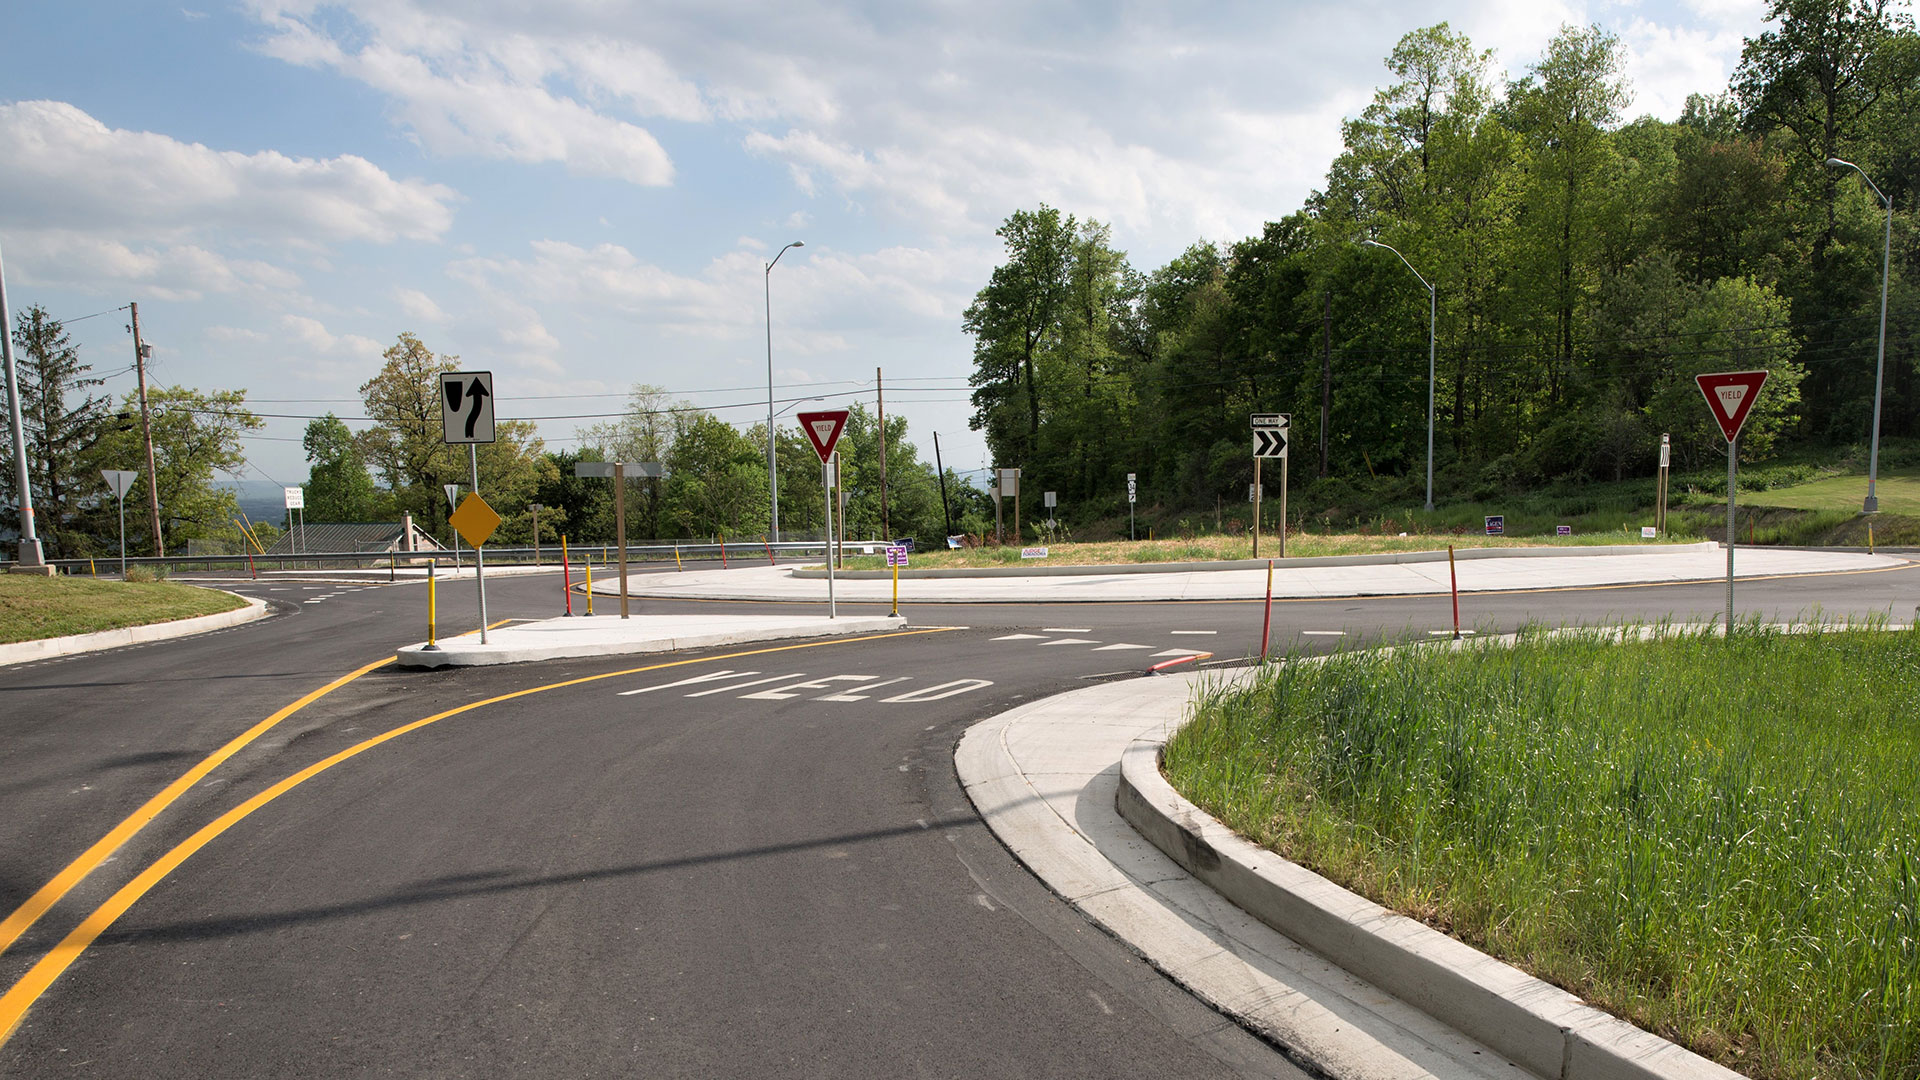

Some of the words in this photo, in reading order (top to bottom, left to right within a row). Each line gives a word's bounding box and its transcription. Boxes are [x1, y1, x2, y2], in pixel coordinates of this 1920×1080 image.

[1720, 390, 1742, 400] YIELD
[815, 424, 832, 432] YIELD
[616, 670, 994, 703] YIELD
